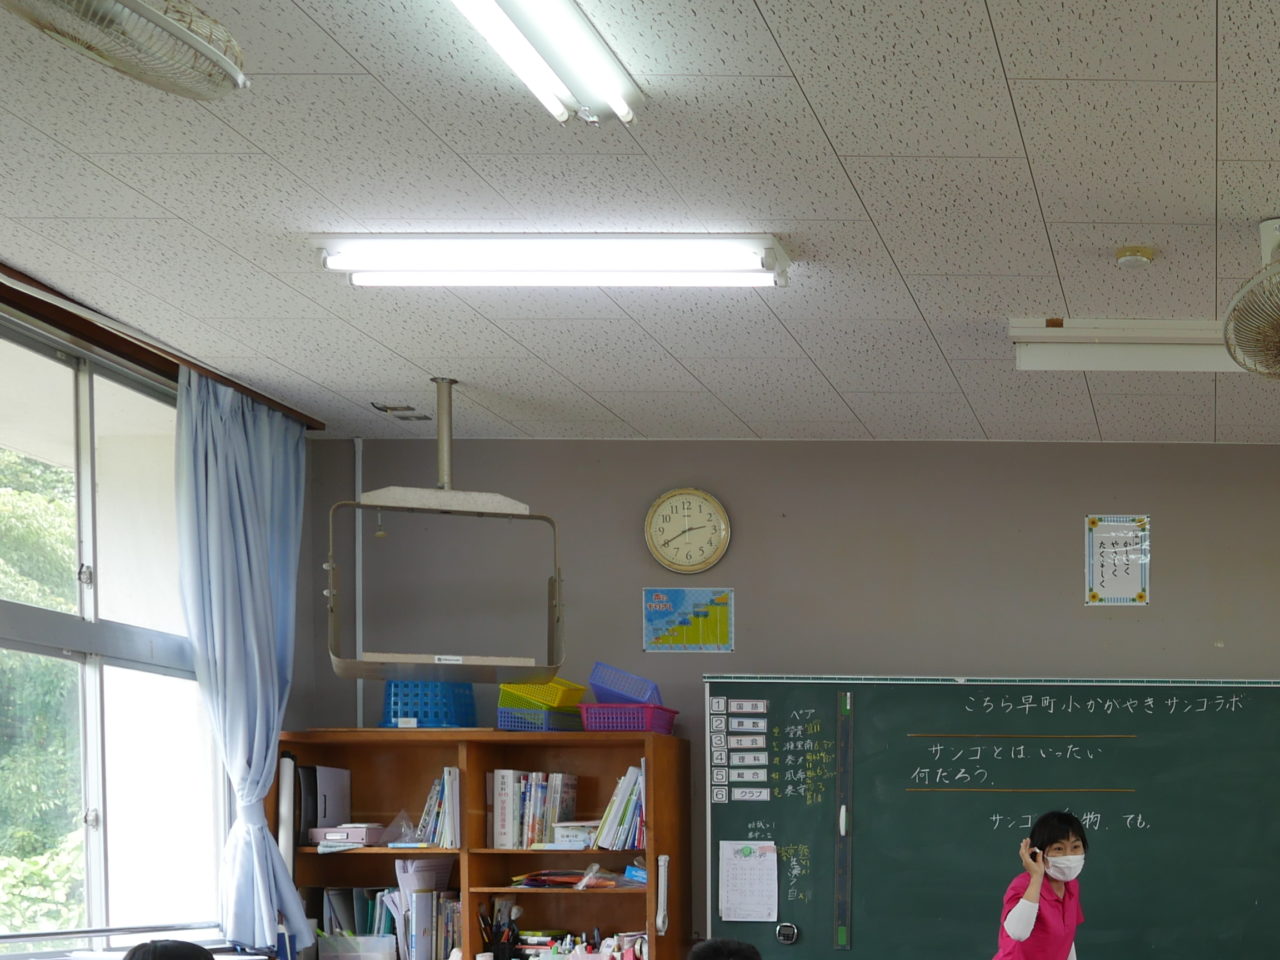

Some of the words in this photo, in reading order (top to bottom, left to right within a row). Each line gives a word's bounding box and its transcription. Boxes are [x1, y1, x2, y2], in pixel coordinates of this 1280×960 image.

[682, 500, 692, 510] 12
[662, 514, 671, 523] 10
[706, 513, 713, 522] 2
[658, 527, 664, 536] 9
[711, 525, 717, 534] 3
[706, 538, 713, 547] 4
[685, 551, 692, 560] 6
[698, 547, 705, 556] 5
[716, 701, 721, 710] 1
[715, 719, 723, 729] 2
[714, 736, 723, 745] 3
[715, 752, 724, 762] 4
[738, 755, 761, 763] 理科
[715, 771, 724, 781] 5
[737, 771, 760, 779] 総合
[715, 790, 725, 800] 6
[739, 790, 763, 798] クラブ
